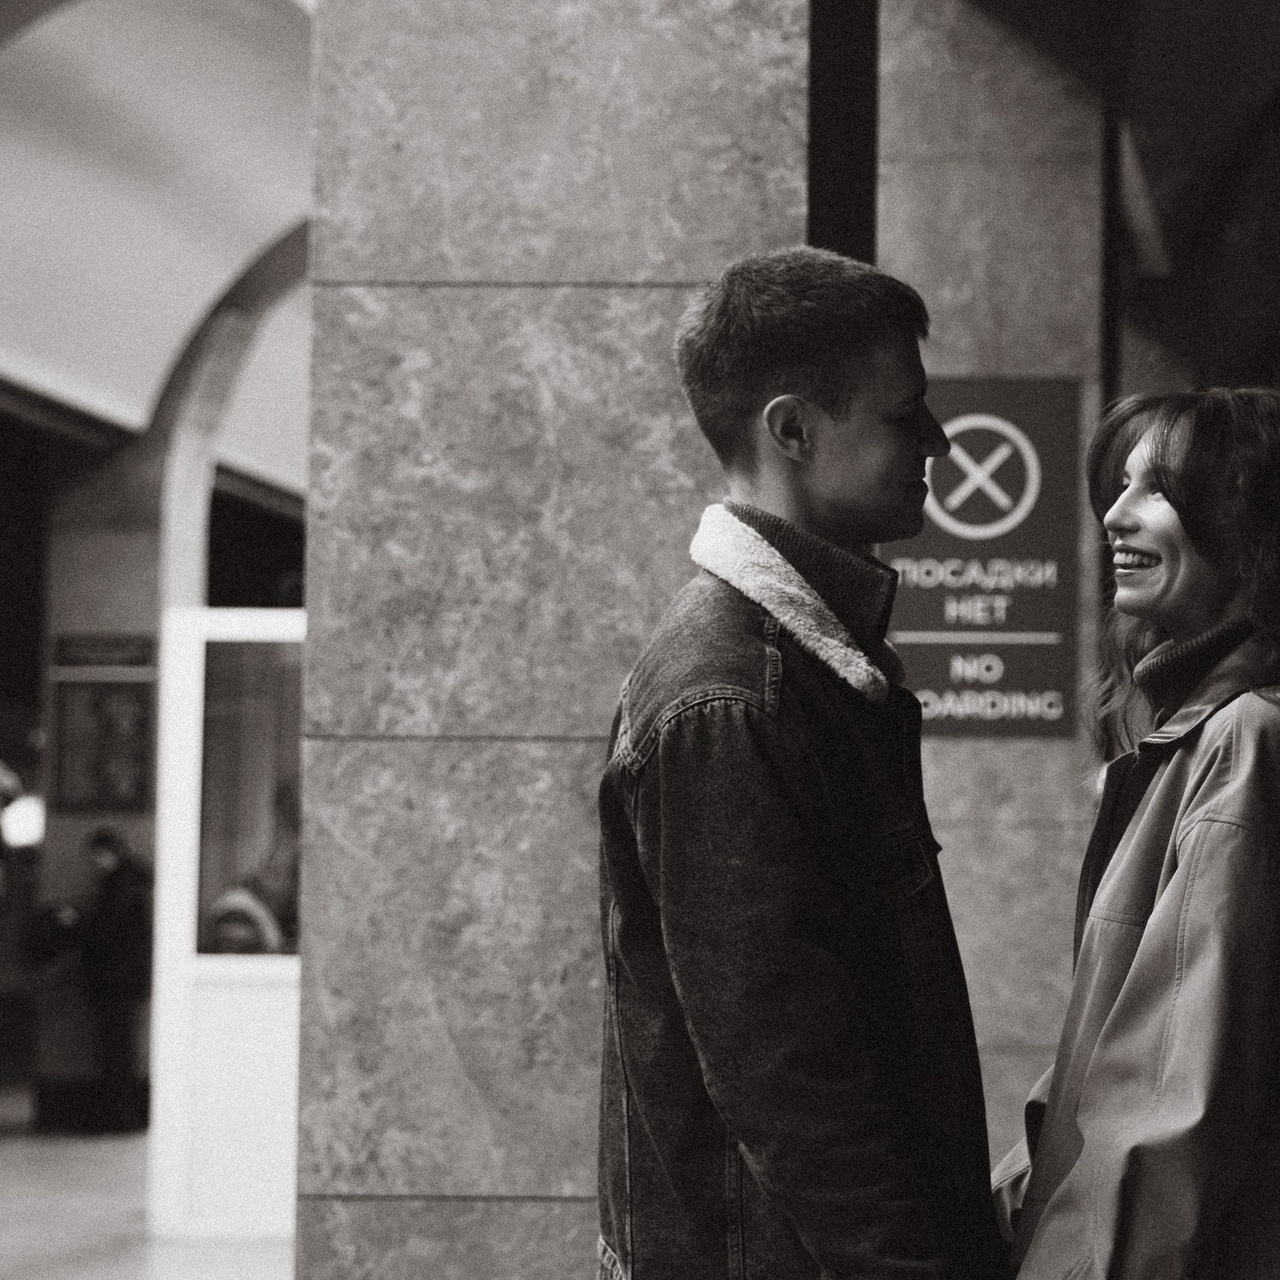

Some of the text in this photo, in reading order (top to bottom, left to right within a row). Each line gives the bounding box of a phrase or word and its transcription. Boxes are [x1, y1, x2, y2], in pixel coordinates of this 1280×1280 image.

[893, 557, 1058, 590] ПОСАДКИ
[943, 596, 1010, 624] НЕТ
[949, 654, 1006, 683] NO
[917, 690, 1064, 720] OARDING
